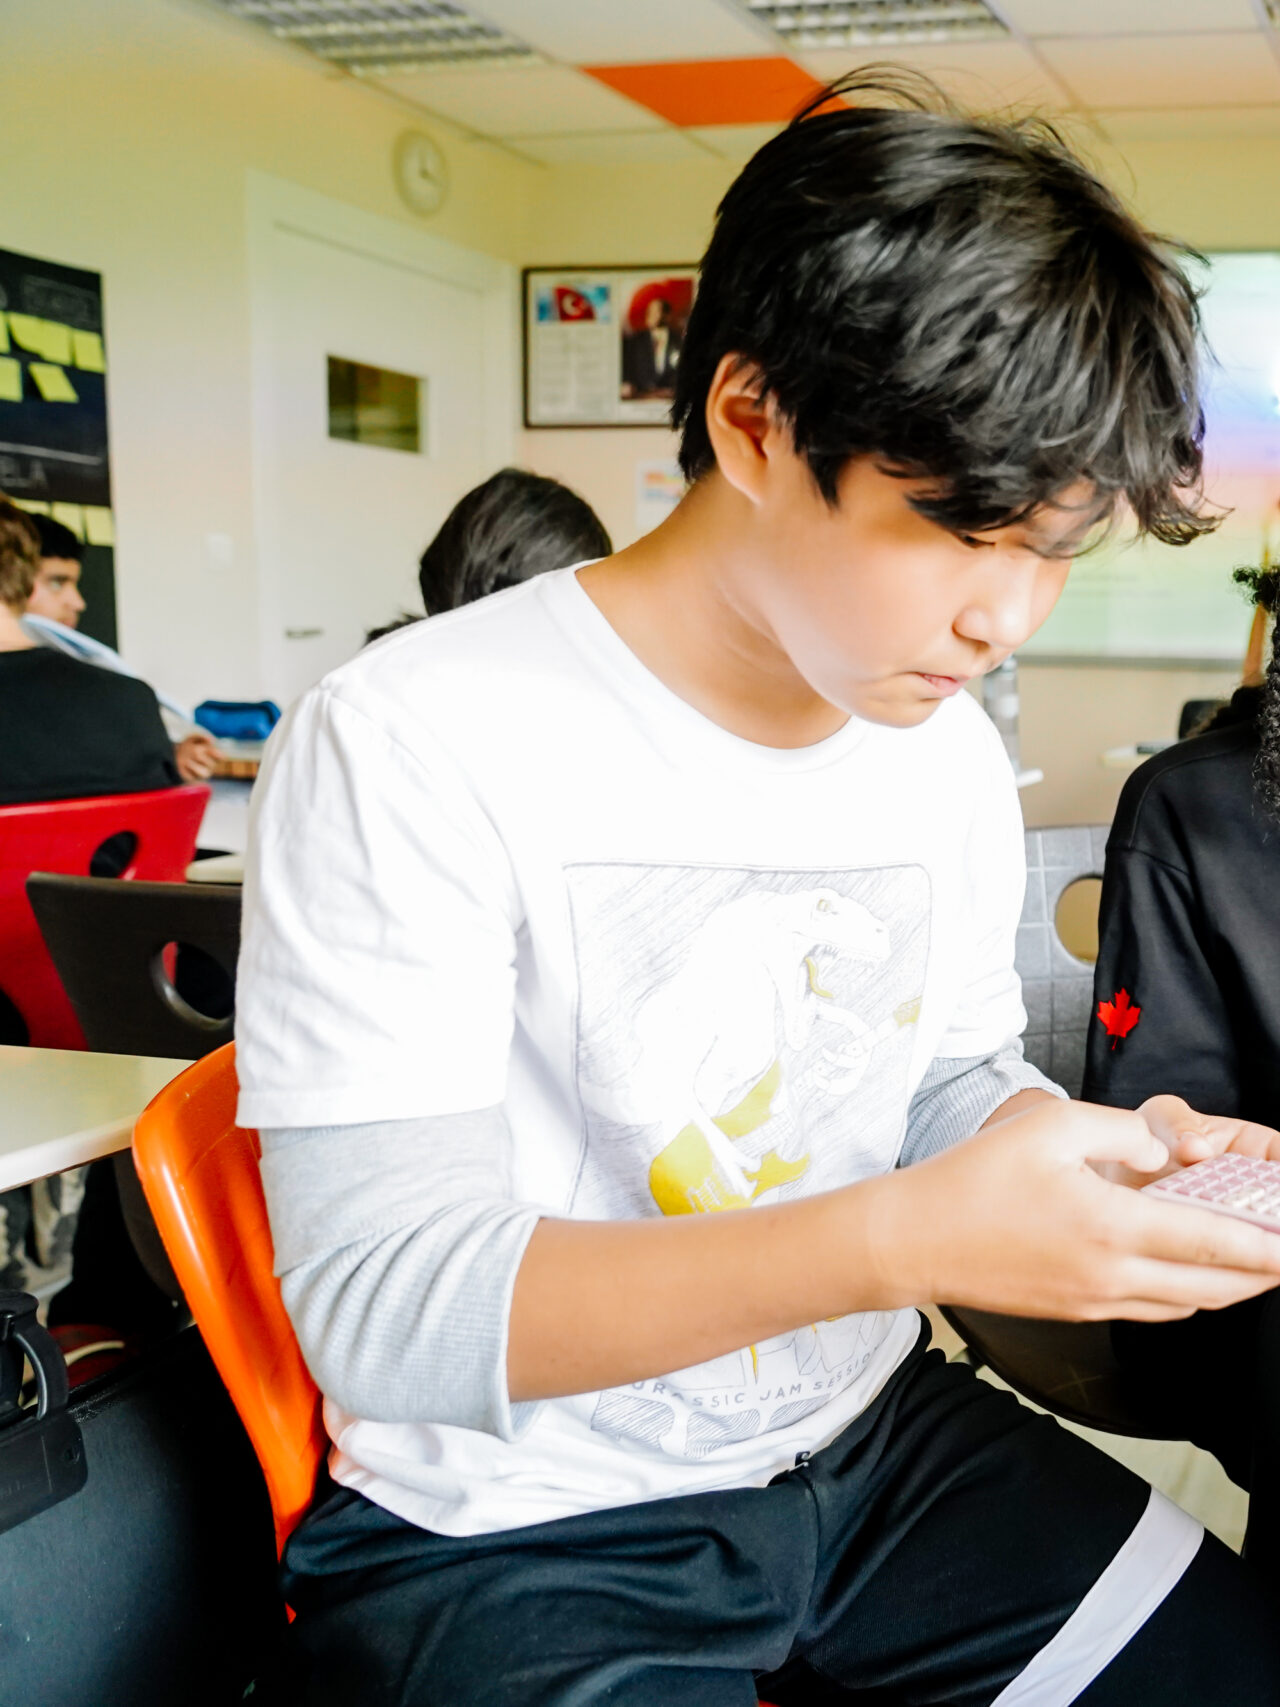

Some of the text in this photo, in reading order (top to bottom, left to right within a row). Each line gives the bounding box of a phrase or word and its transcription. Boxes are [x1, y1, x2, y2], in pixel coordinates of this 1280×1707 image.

[631, 1346, 878, 1408] URASSIC JAM SESSIO
